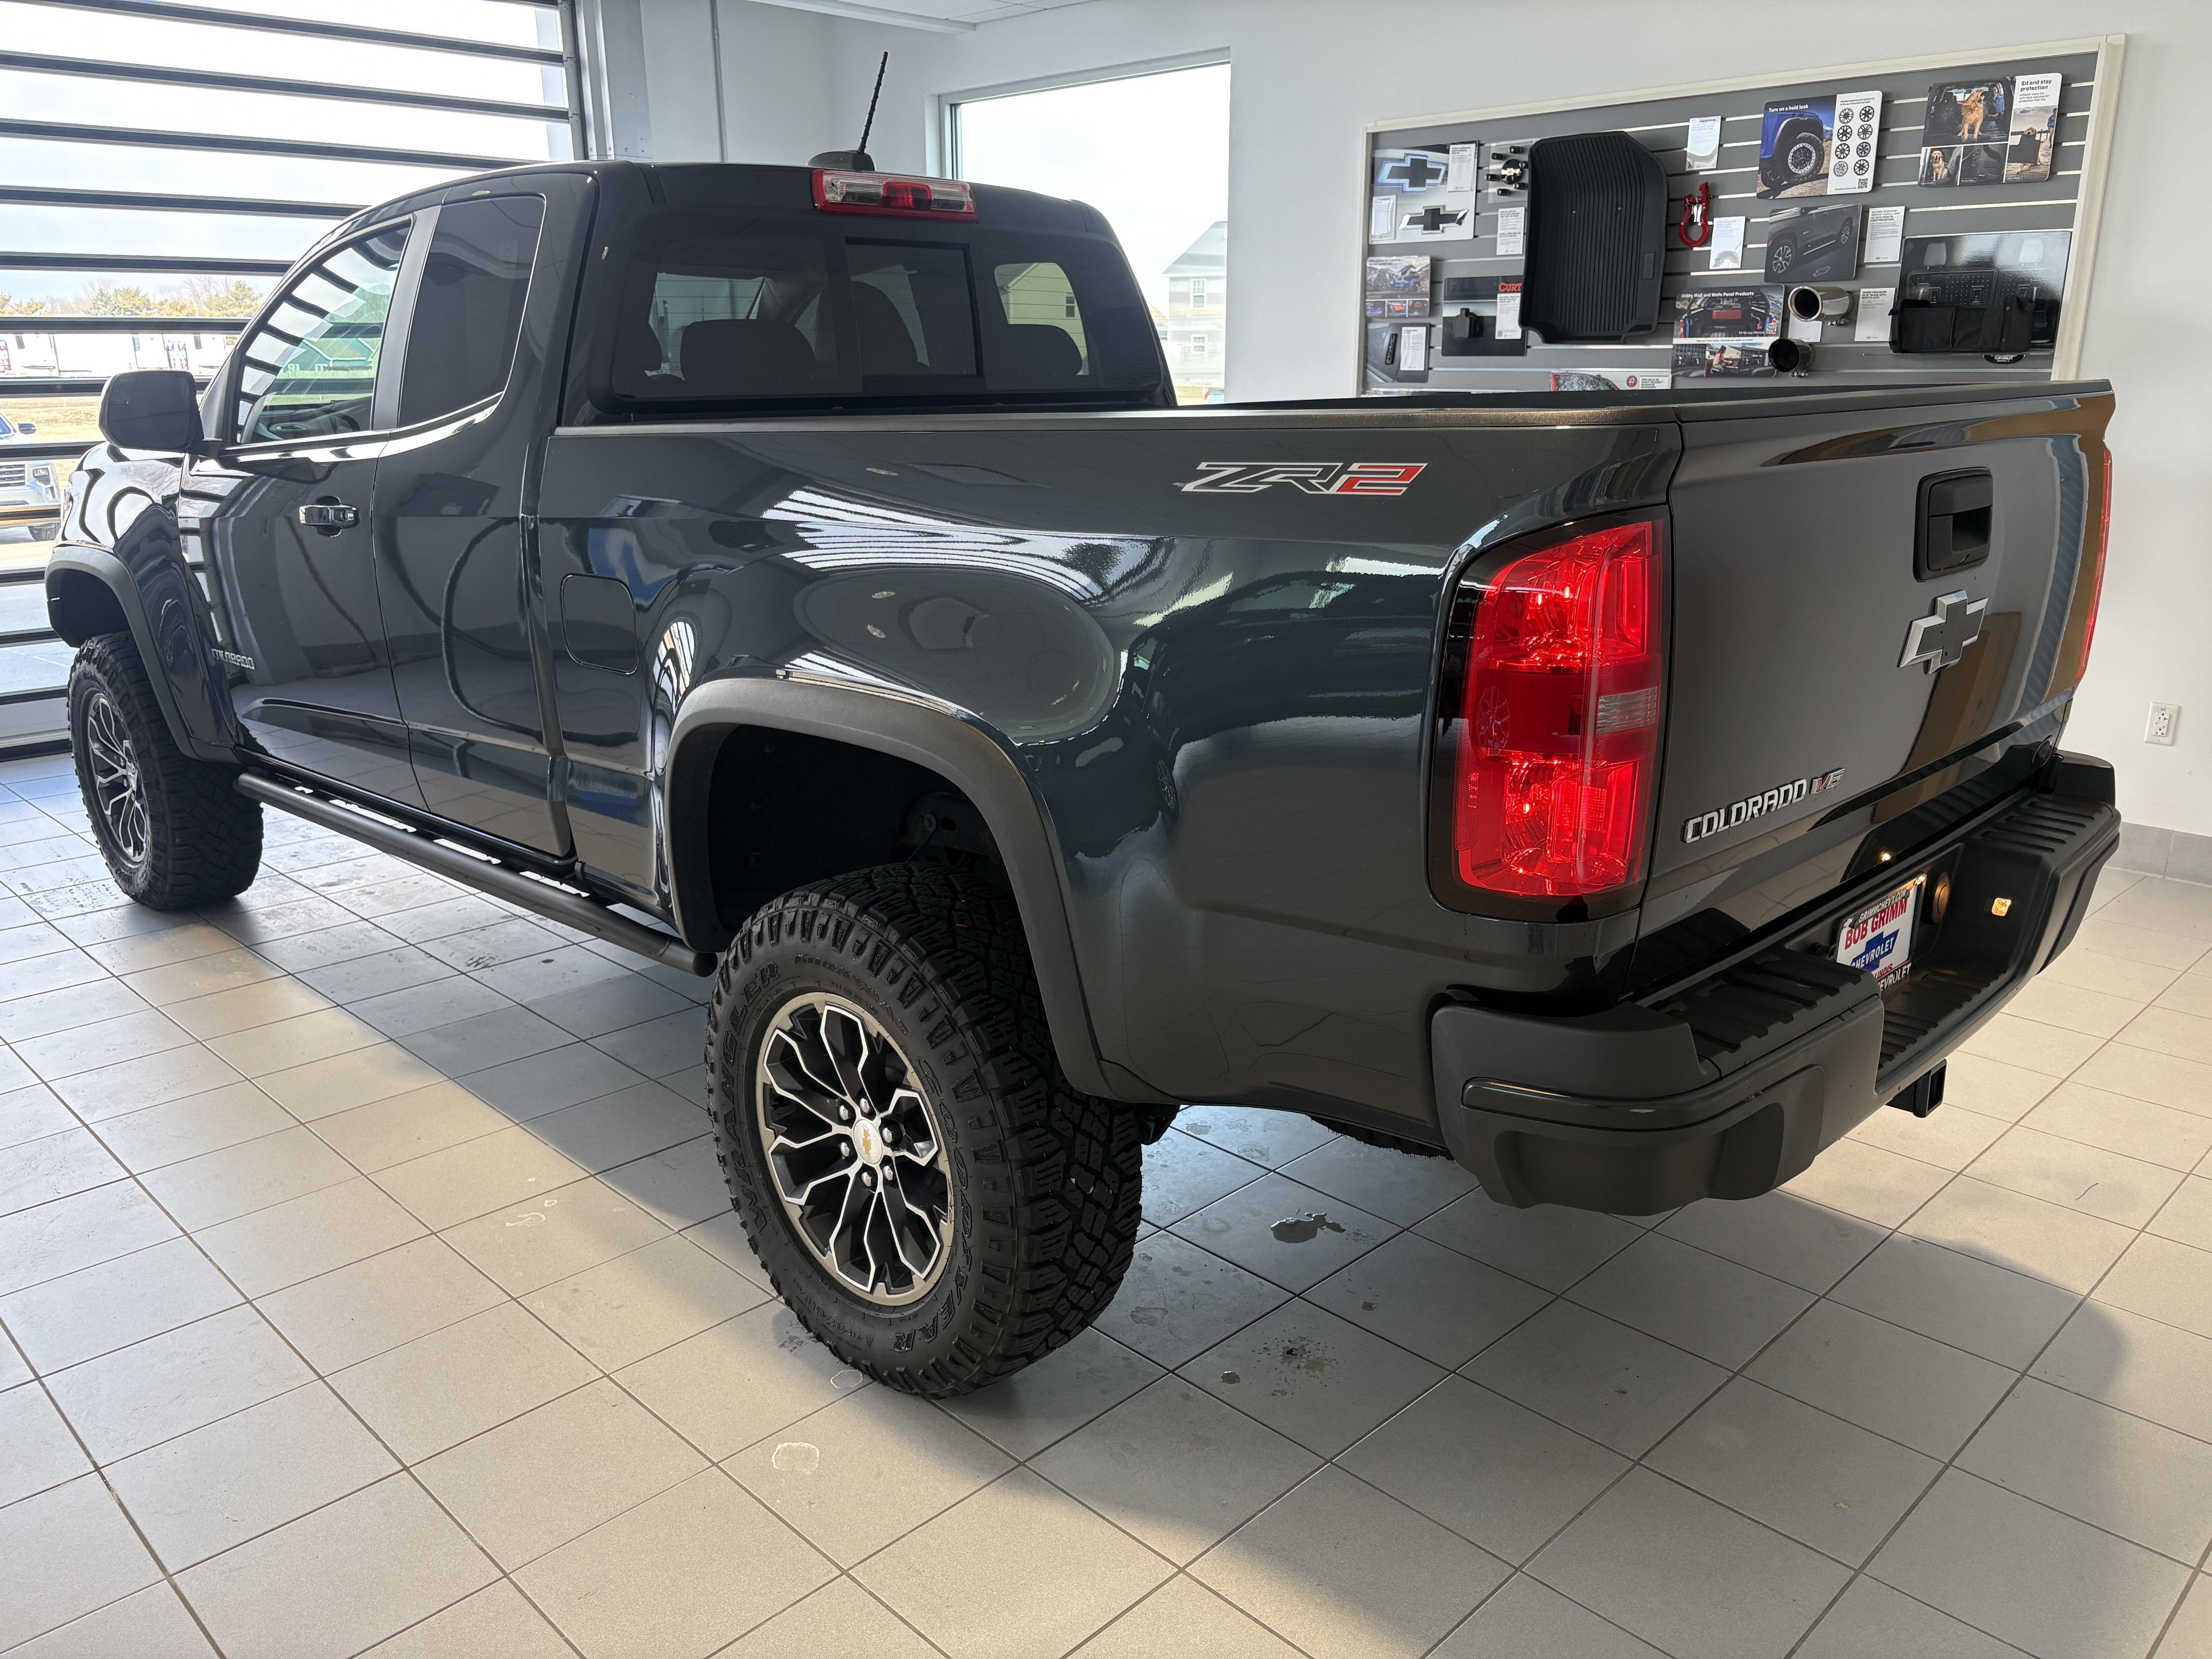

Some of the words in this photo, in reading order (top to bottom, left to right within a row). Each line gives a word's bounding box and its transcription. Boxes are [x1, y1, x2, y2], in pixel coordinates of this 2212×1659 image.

[1499, 282, 1522, 292] CURT
[1182, 462, 1428, 496] ZR2
[211, 648, 255, 670] COLORADO
[1683, 778, 1807, 843] COLORADO
[1810, 768, 1845, 794] V6
[1844, 920, 1869, 950] BOB
[1871, 897, 1908, 933] GRIMM
[1851, 937, 1894, 969] CHEVROLET
[1878, 962, 1912, 991] EVROLET
[721, 961, 780, 1233] WRANGLER
[894, 1056, 973, 1352] GOODYEAR
